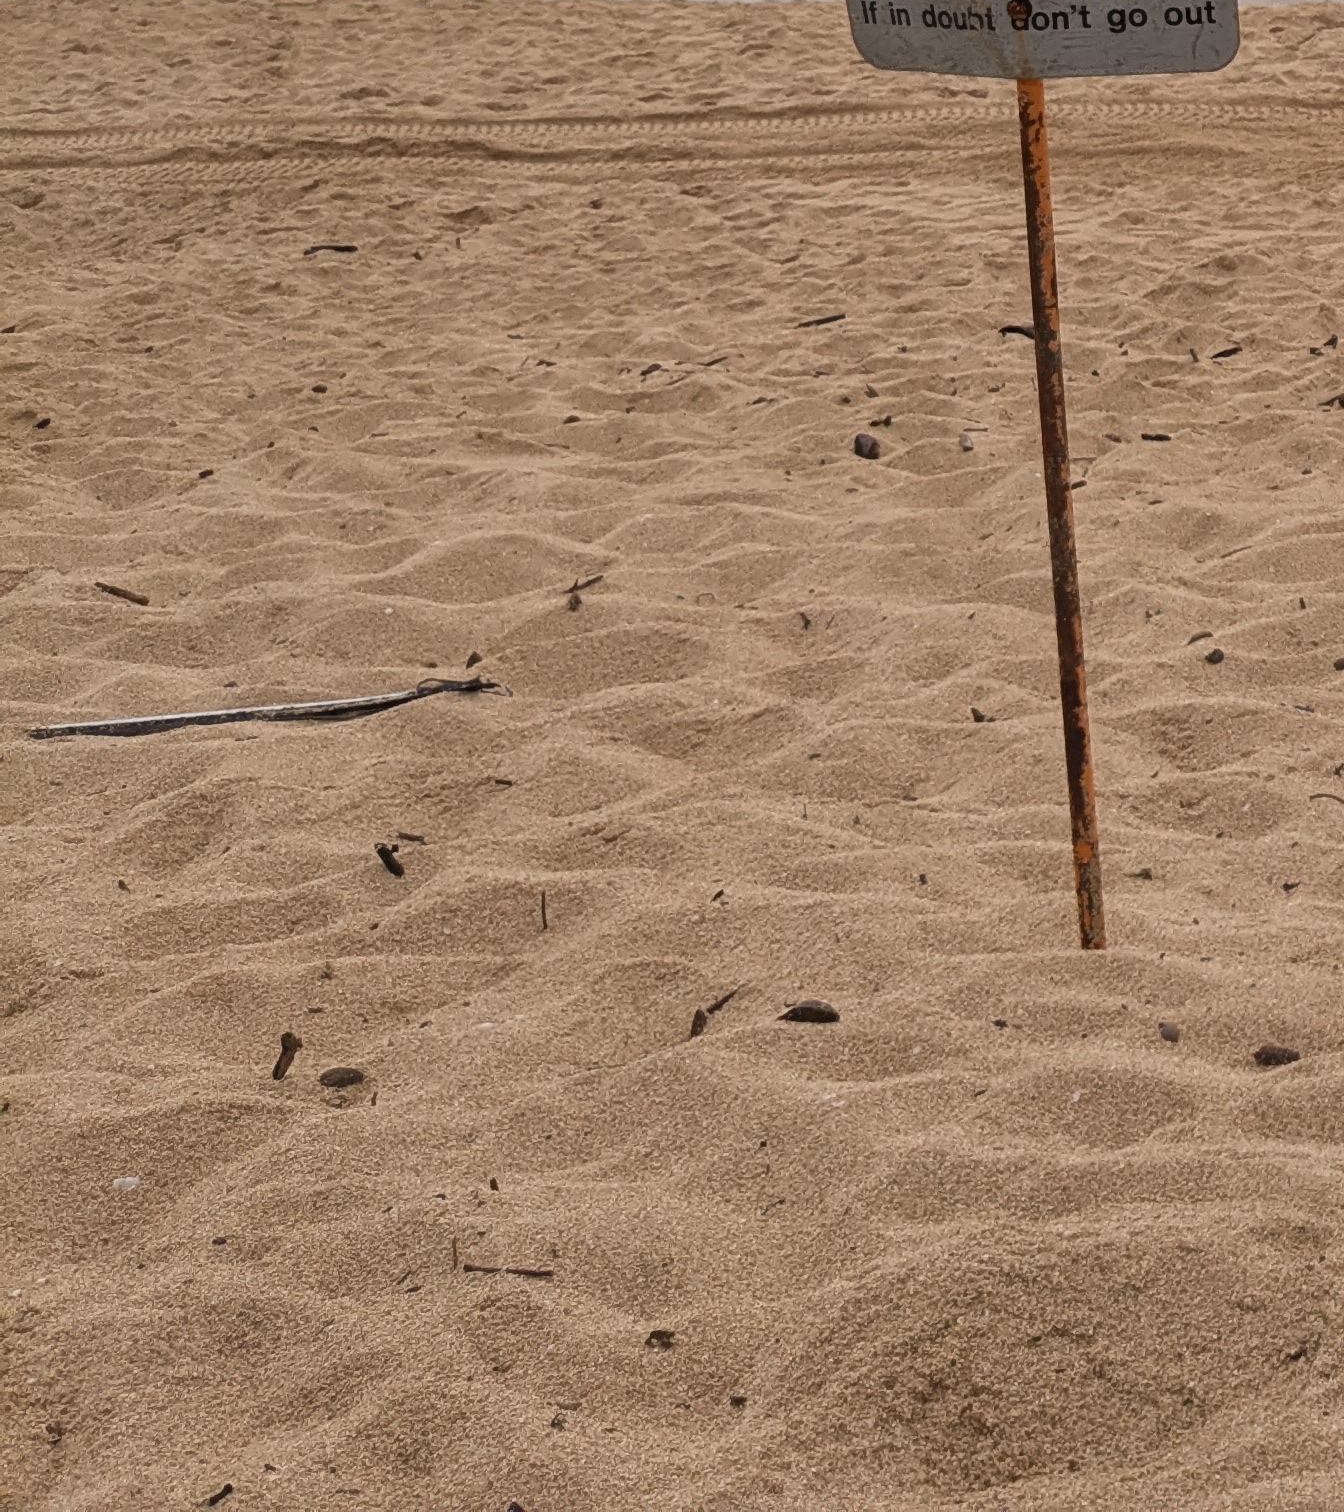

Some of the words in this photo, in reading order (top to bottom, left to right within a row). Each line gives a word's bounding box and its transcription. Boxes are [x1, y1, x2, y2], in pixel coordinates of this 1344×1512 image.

[861, 0, 877, 24] If
[890, 1, 911, 26] in
[922, 4, 996, 31] doubt
[1107, 7, 1148, 33] go
[1164, 1, 1216, 25] out
